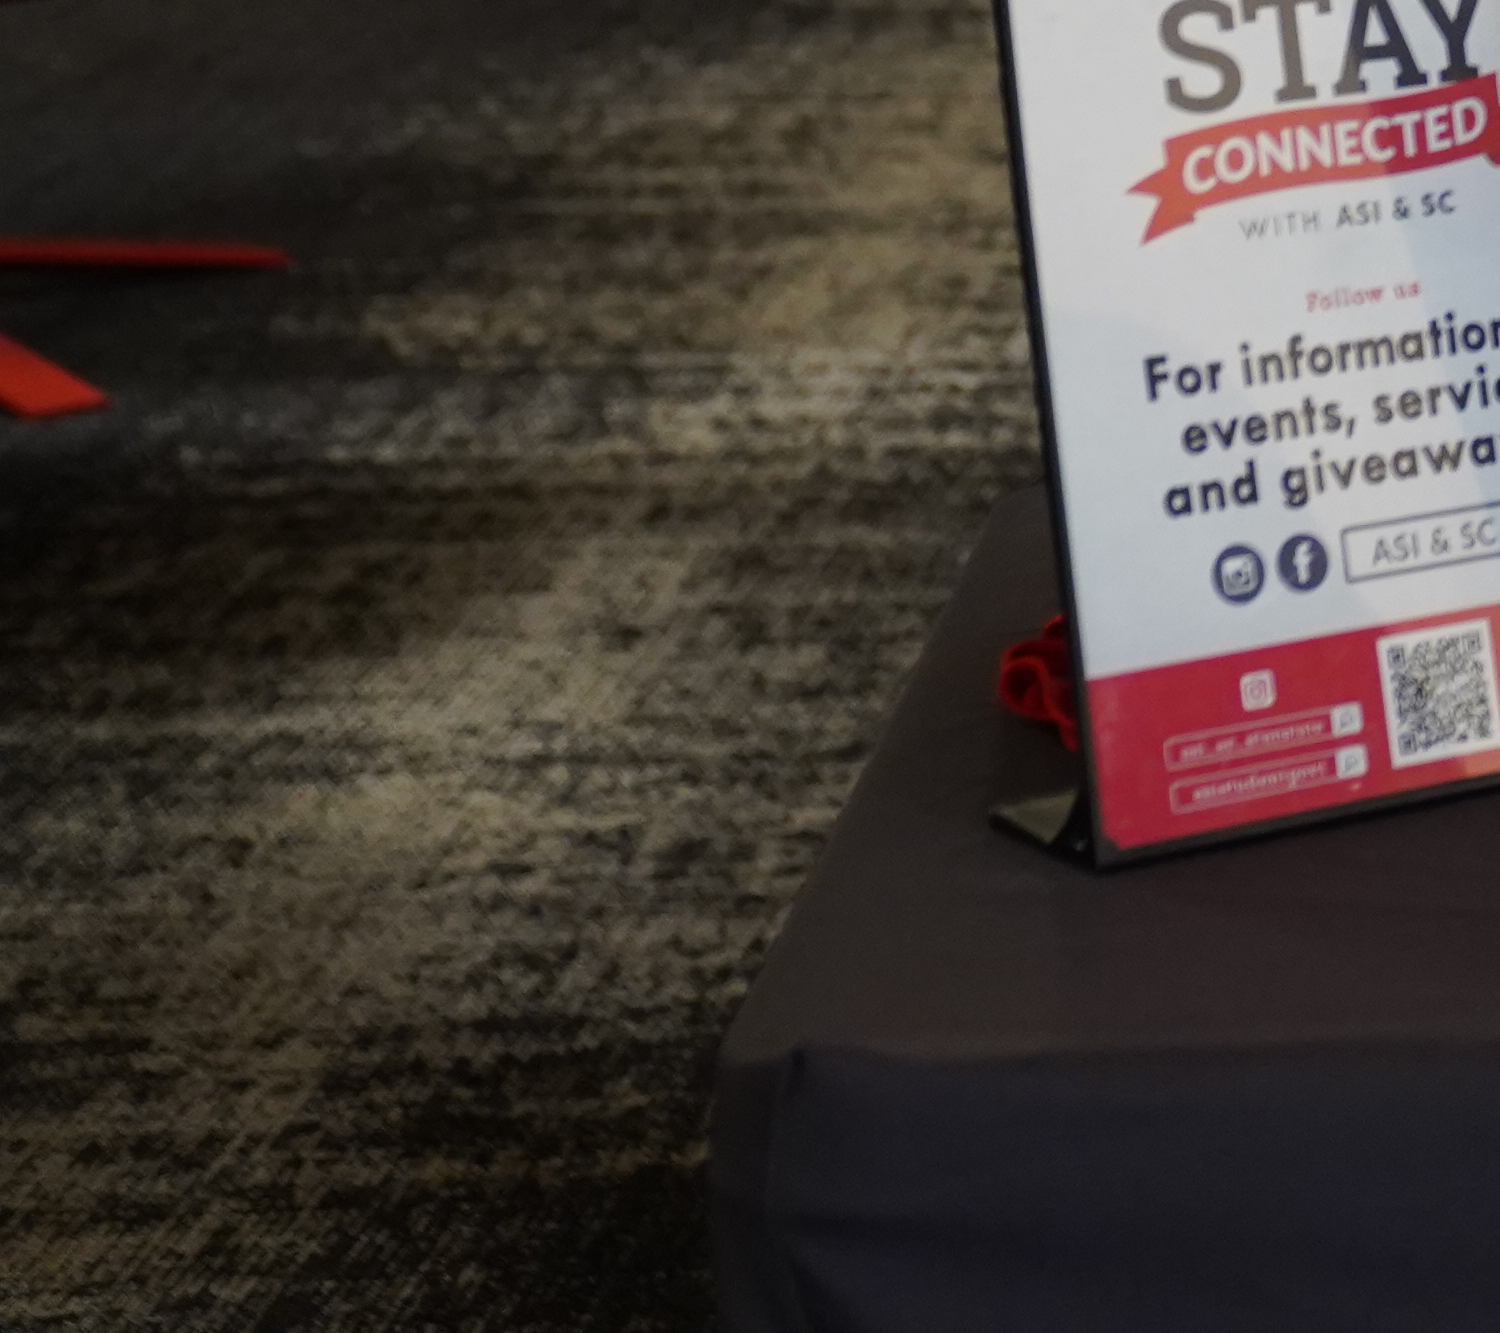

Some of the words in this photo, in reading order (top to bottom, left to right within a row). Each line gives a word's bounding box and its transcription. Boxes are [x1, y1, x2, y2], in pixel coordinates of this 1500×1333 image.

[1181, 97, 1488, 195] CONNECTED
[1239, 211, 1321, 241] WITH
[1335, 200, 1382, 228] ASI
[1392, 197, 1410, 221] &
[1421, 190, 1458, 216] SC
[1305, 285, 1384, 314] Follow
[1394, 281, 1422, 301] us
[1143, 353, 1225, 402] For
[1181, 394, 1357, 456] events,
[1163, 460, 1259, 519] and
[1371, 533, 1422, 567] ASI
[1429, 530, 1451, 556] &
[1458, 517, 1498, 549] SC
